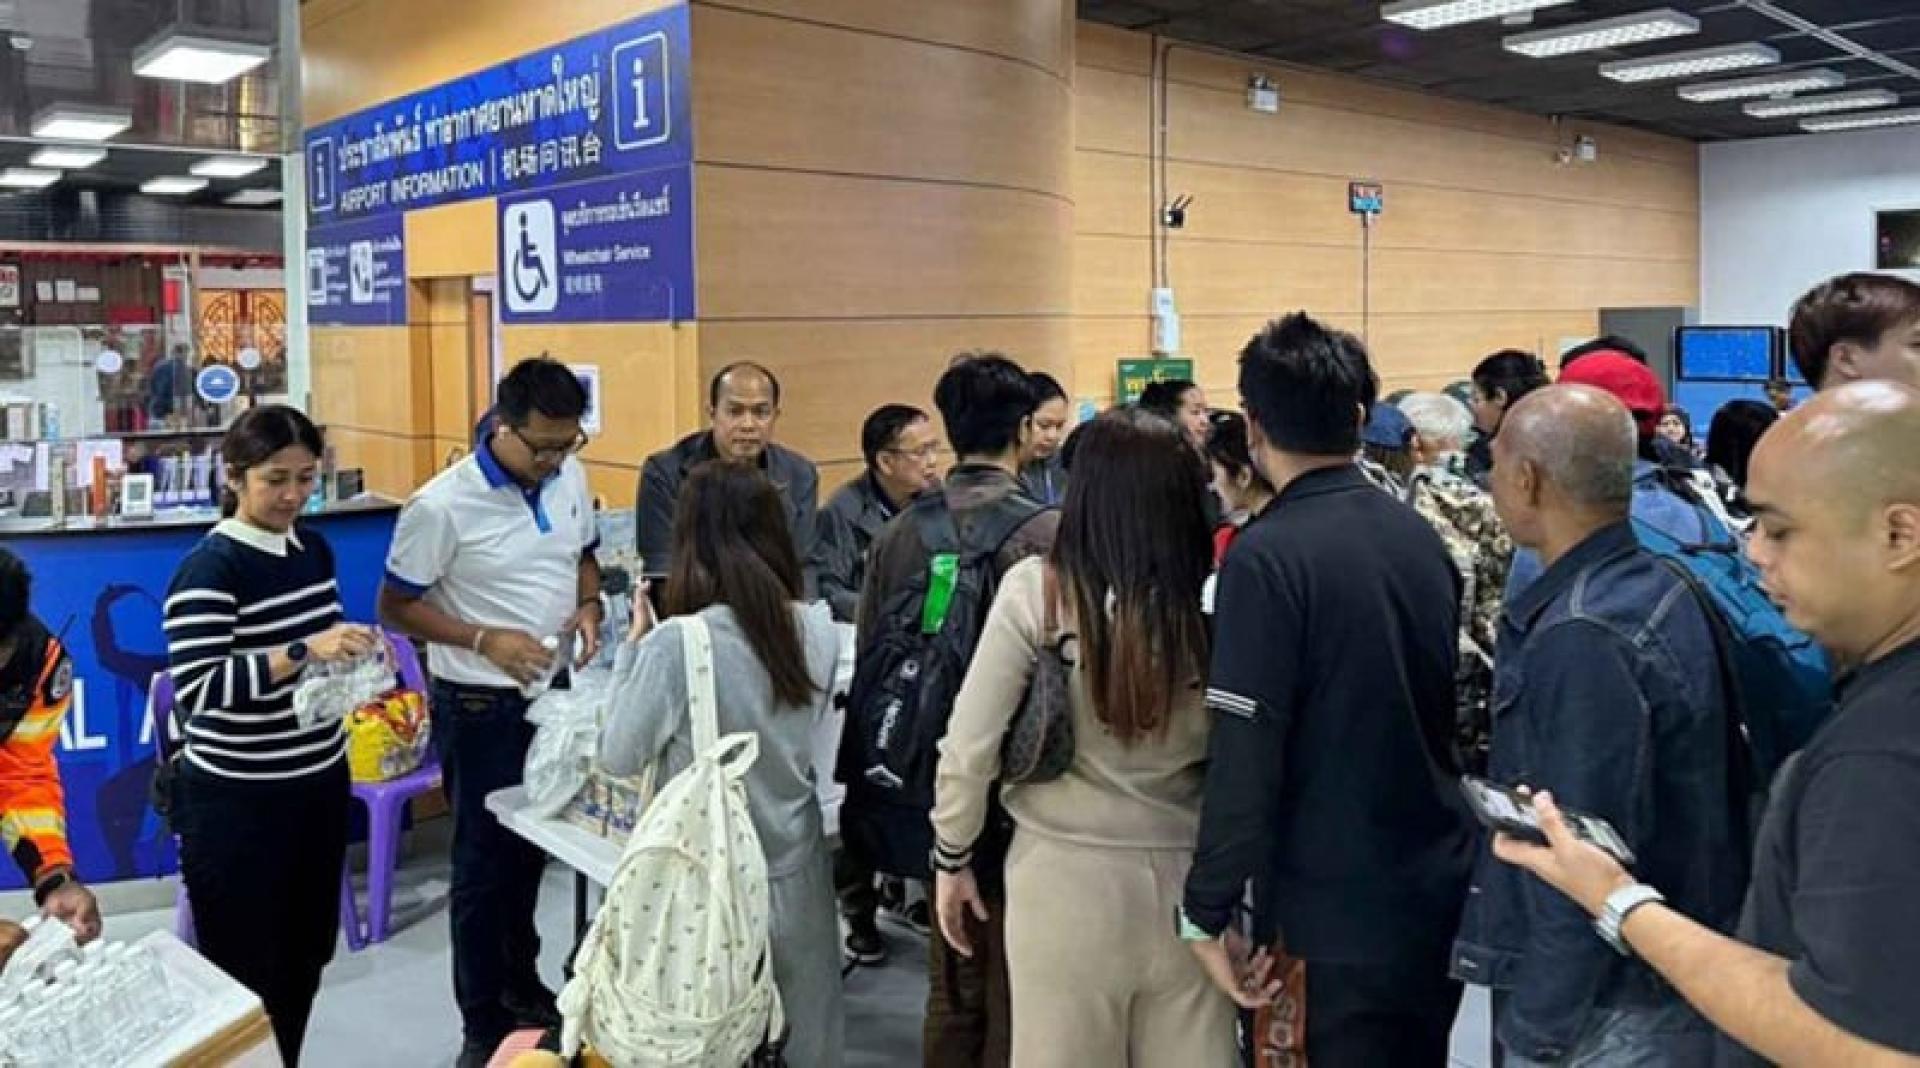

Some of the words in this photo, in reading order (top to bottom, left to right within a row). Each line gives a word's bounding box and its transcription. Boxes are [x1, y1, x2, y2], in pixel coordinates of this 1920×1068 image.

[424, 53, 600, 147] ท่าอากาศยานหาดใหญ่
[502, 128, 602, 181] 机场问讯台
[339, 180, 387, 213] AIRPORT
[390, 160, 485, 203] INFORMATION
[613, 244, 650, 262] Service
